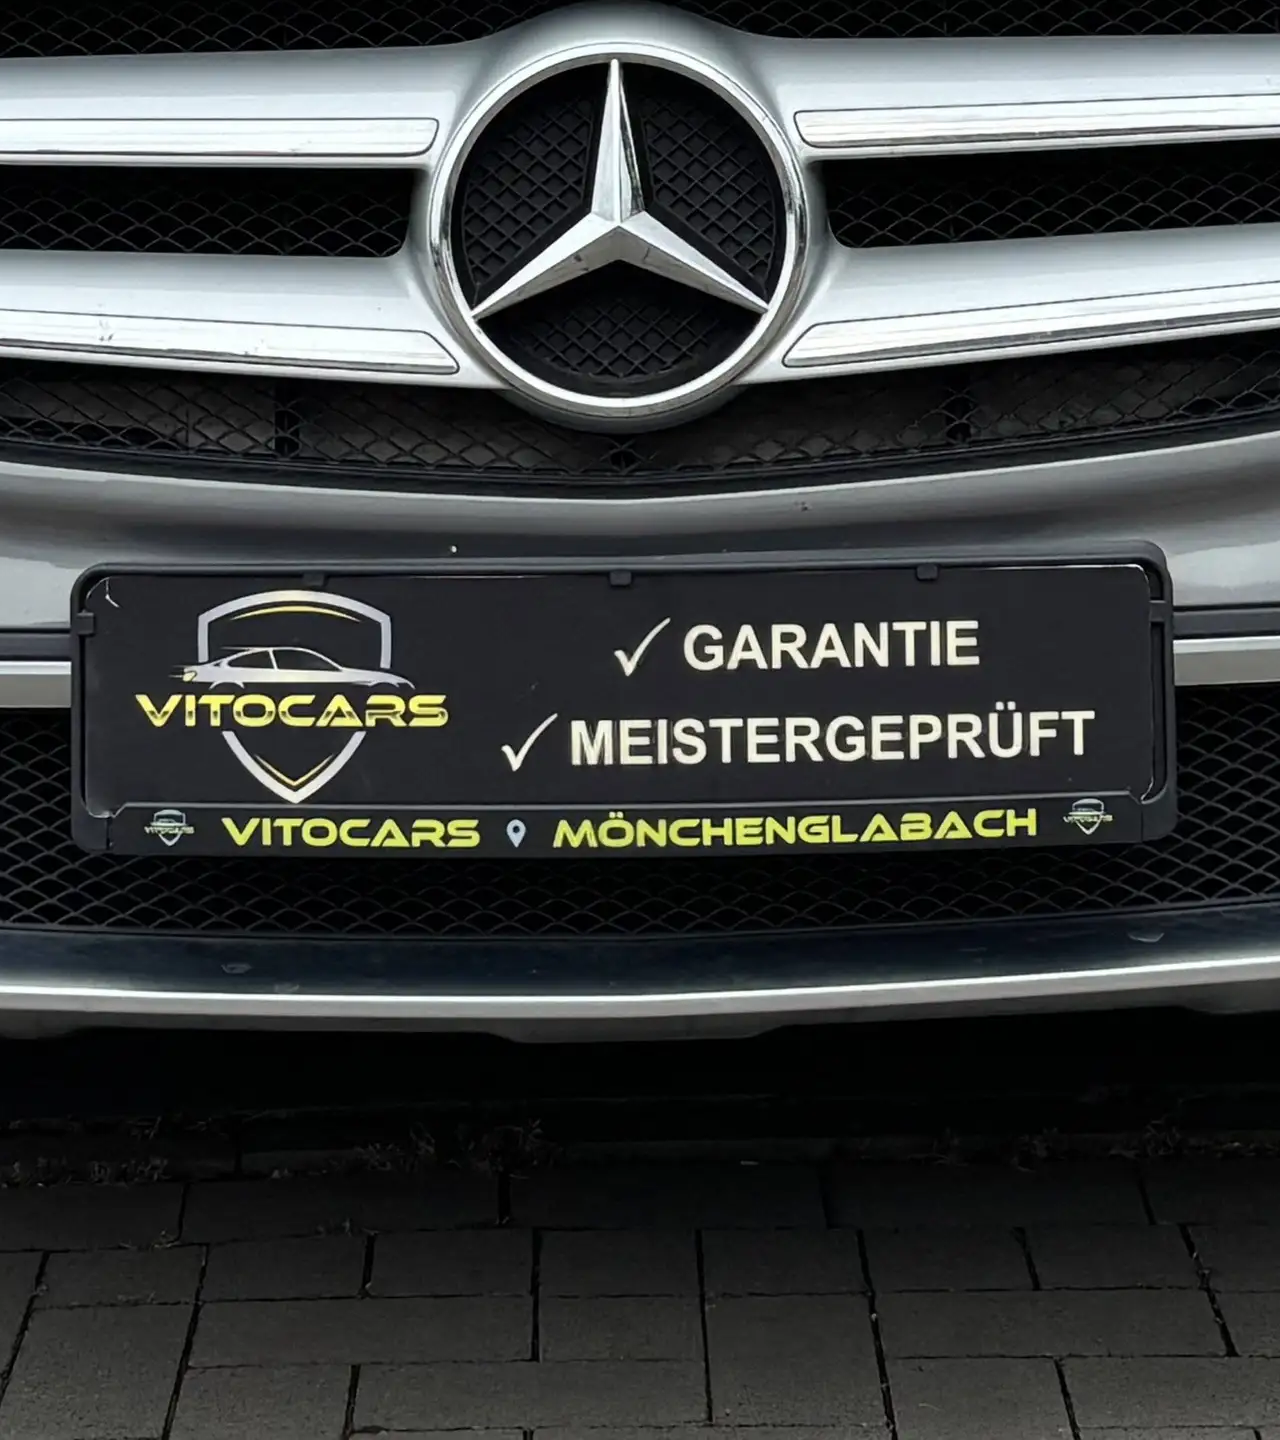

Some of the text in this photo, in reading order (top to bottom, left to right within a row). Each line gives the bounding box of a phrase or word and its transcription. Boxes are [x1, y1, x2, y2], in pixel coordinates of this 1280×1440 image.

[683, 620, 980, 671] GARANTIE
[135, 694, 449, 728] VITOCARS
[570, 701, 1096, 766] MEISTERGEPRÜFT
[221, 808, 1038, 848] VITOCARS MÖNCHENGLABACH
